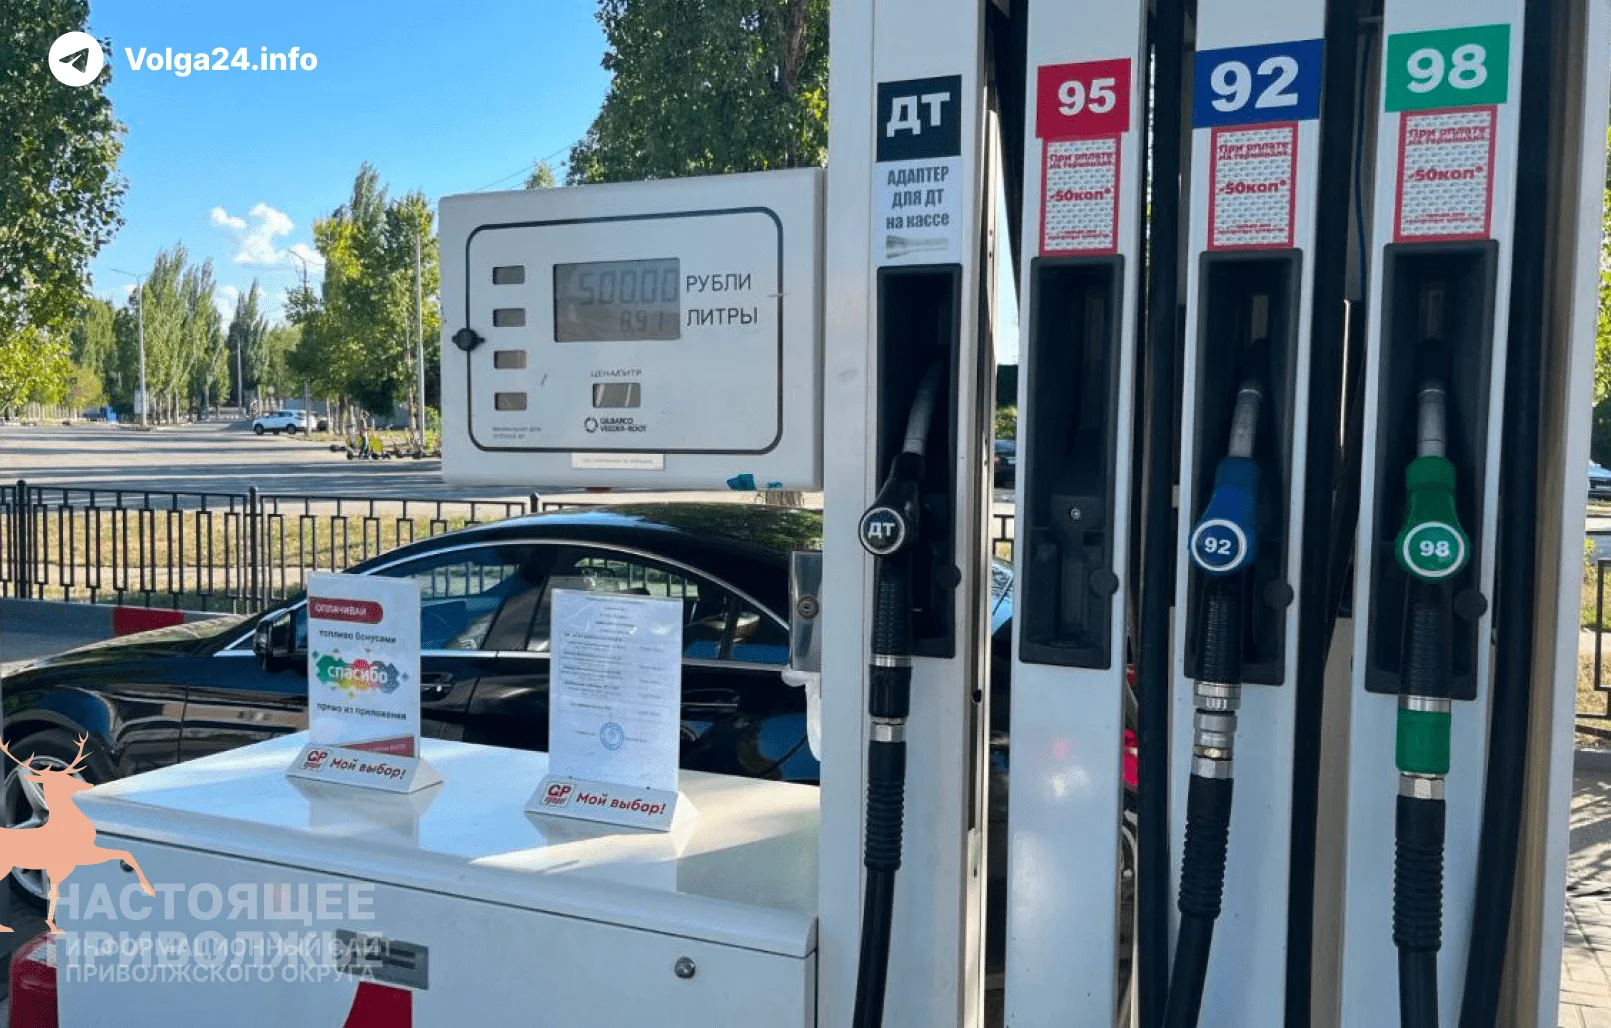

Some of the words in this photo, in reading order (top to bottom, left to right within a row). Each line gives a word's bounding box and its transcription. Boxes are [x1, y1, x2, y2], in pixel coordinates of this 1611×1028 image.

[1406, 44, 1488, 94] 98
[1210, 56, 1299, 112] 92
[1057, 77, 1117, 116] 95
[886, 92, 951, 138] ДТ
[1219, 143, 1243, 153] При
[1246, 141, 1289, 151] оплате
[887, 166, 950, 187] АДАПТЕР
[891, 190, 922, 210] ДЛЯ
[924, 189, 945, 207] ДТ
[886, 216, 904, 230] на
[906, 213, 951, 229] кассе
[686, 273, 751, 293] РУБЛИ
[686, 306, 758, 327] ЛИТРЫ
[867, 522, 896, 539] ДТ
[1204, 537, 1232, 555] 92
[1420, 540, 1450, 558] 98
[327, 666, 389, 684] спасибо
[330, 758, 359, 771] Мой
[360, 763, 407, 780] выбор!
[576, 791, 608, 806] Мой
[610, 798, 667, 816] выбор!
